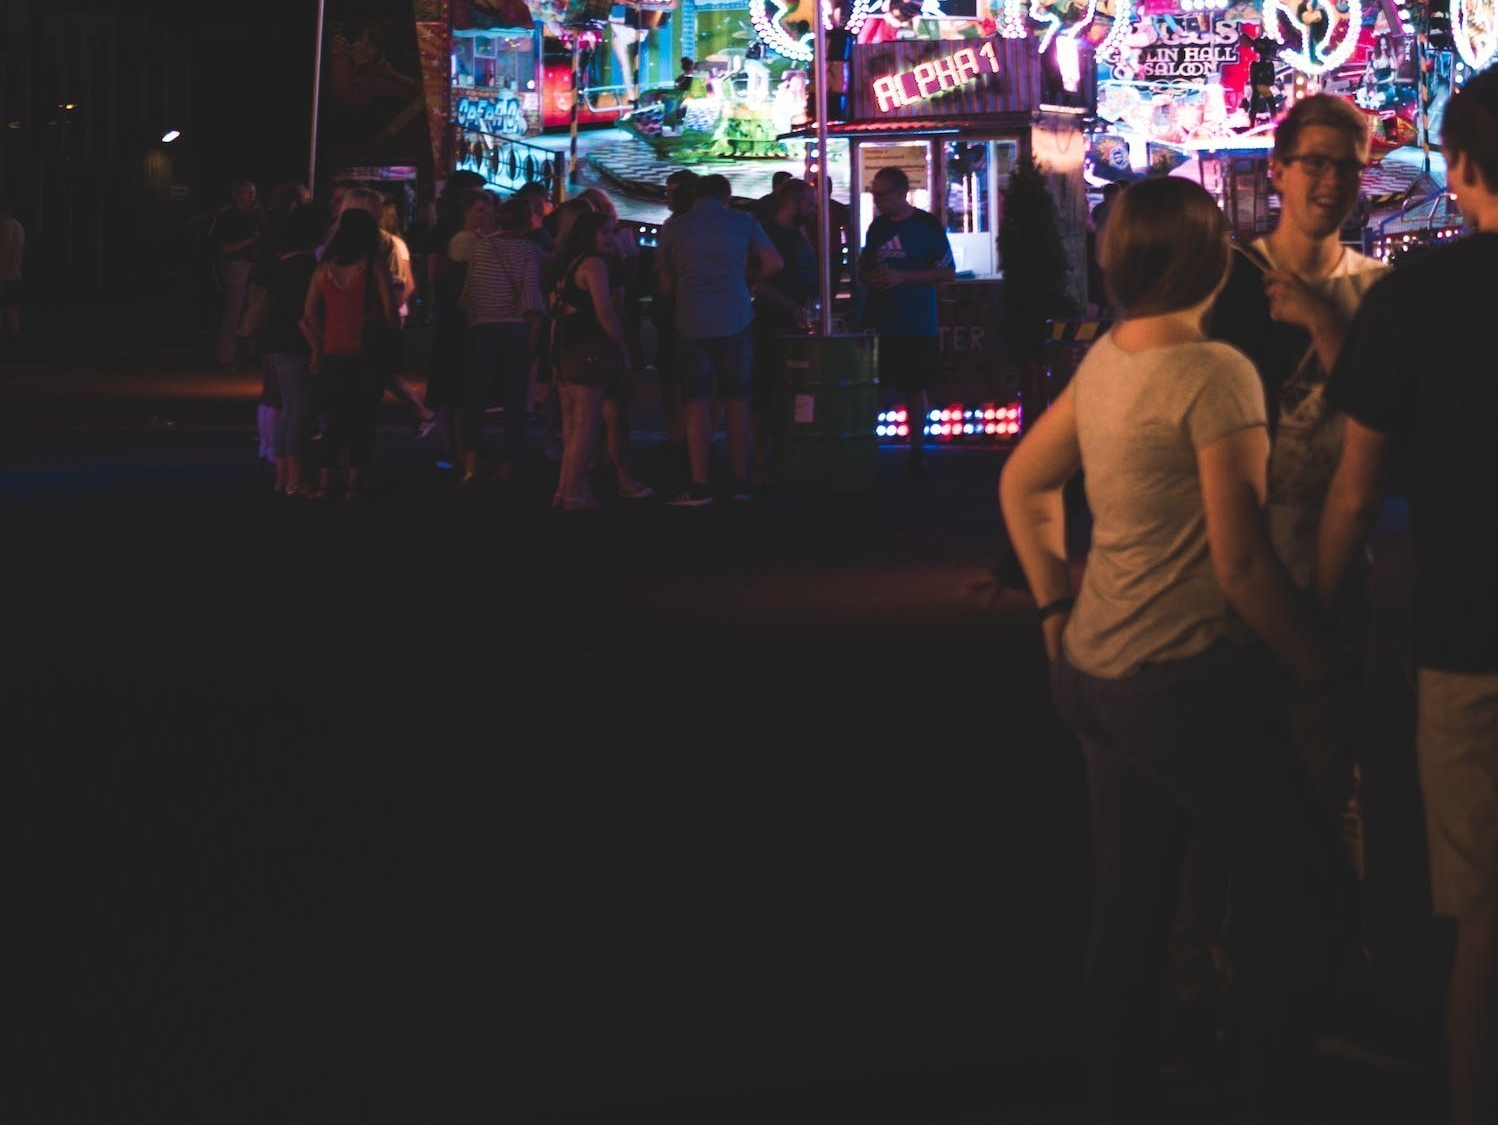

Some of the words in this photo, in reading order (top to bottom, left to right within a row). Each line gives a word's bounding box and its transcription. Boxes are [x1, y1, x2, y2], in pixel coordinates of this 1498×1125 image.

[1183, 47, 1236, 63] HALL
[873, 47, 980, 113] ALPHA
[979, 41, 1000, 74] 1
[1144, 62, 1219, 77] SALOON
